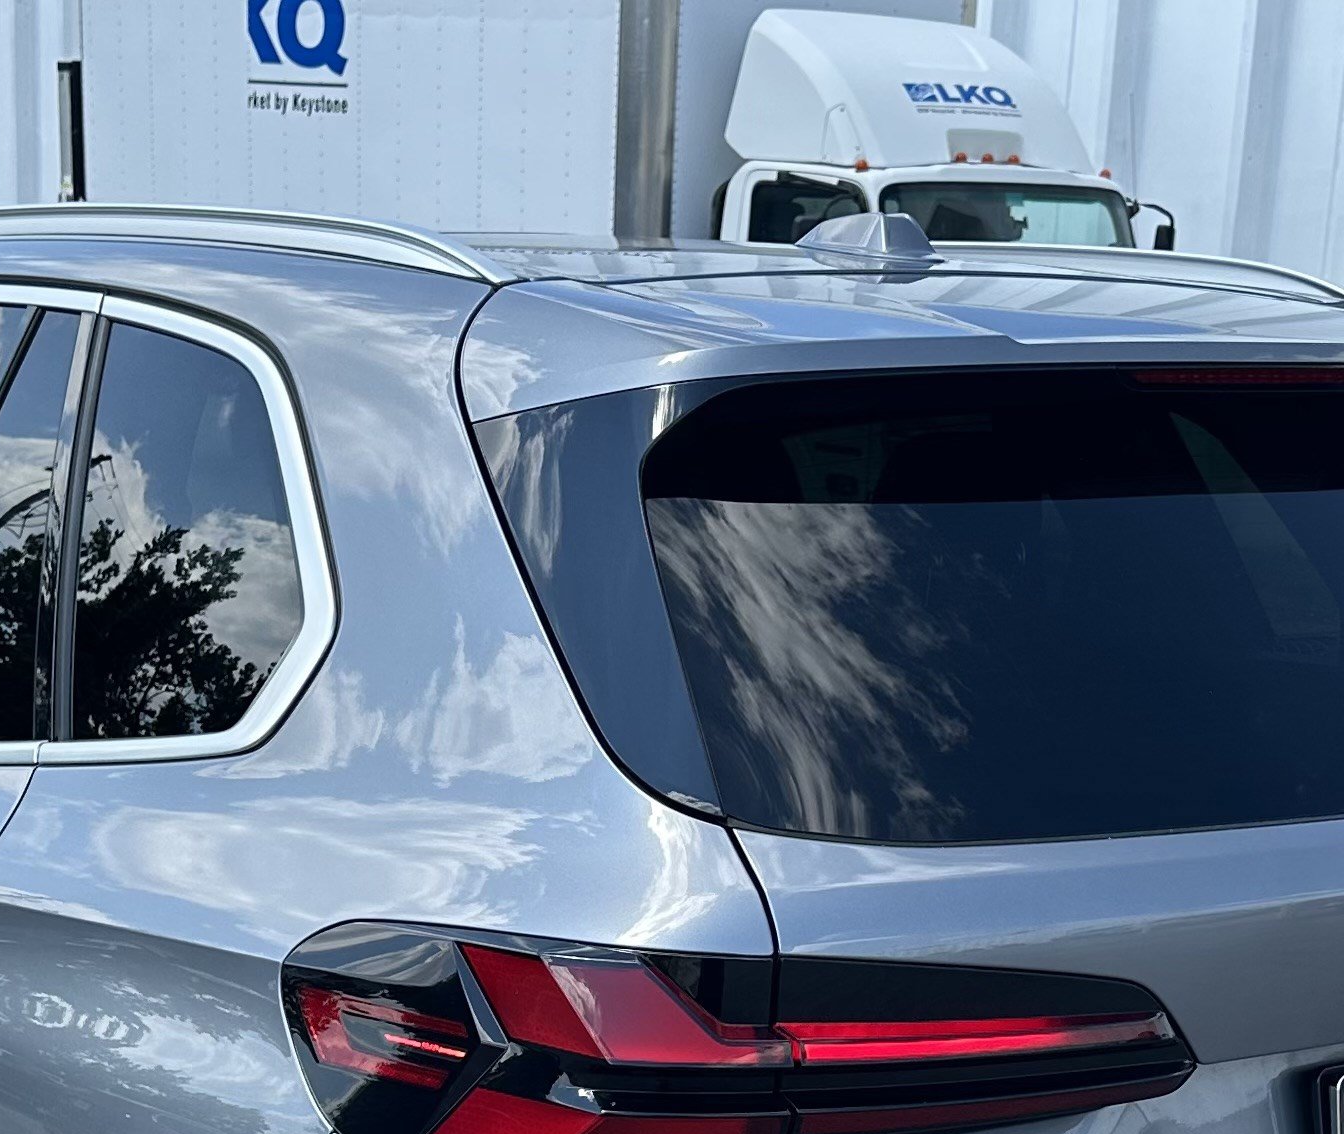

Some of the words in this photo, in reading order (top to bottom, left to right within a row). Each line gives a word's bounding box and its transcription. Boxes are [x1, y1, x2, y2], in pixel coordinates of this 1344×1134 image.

[275, 92, 289, 115] by
[292, 93, 348, 117] Keystone
[934, 83, 1017, 108] LKQ
